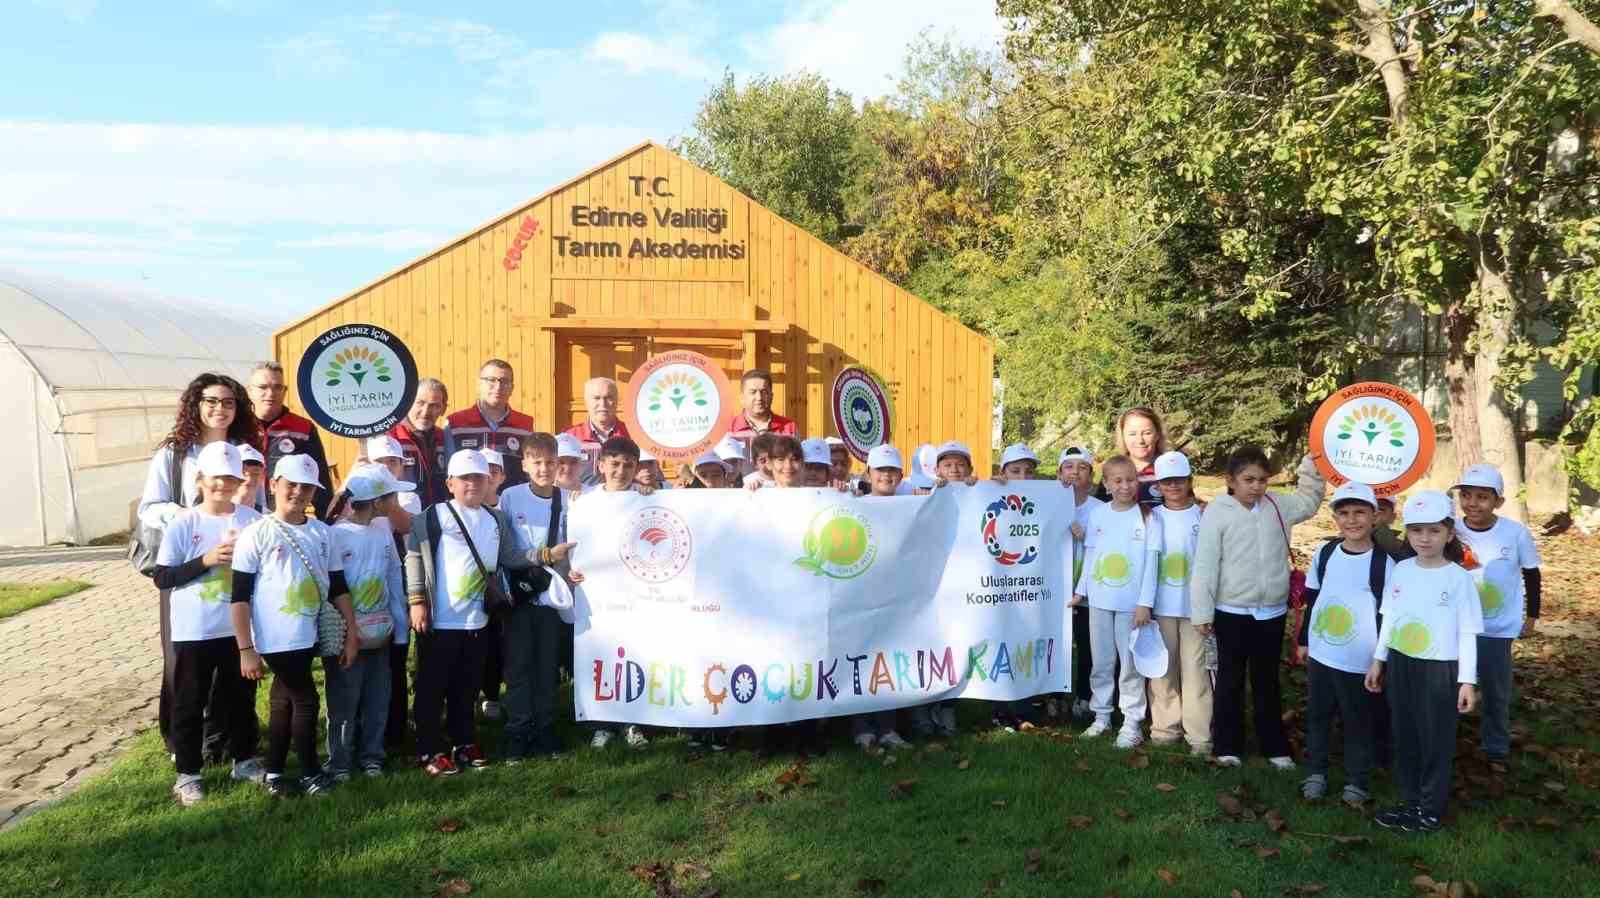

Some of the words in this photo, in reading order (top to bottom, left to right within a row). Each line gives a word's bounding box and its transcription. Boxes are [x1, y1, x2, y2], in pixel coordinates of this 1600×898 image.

[628, 176, 674, 198] T.C.
[571, 205, 647, 228] Edirne
[653, 207, 728, 233] Valiliği
[553, 235, 622, 258] Tarım
[627, 237, 745, 260] Akademisi
[320, 327, 369, 346] SAĞLIĞINIZ
[371, 329, 390, 342] İÇİN
[352, 392, 393, 402] TARIM
[1341, 385, 1393, 399] SAĞLIĞINIZ
[1394, 389, 1414, 405] İÇİN
[330, 422, 342, 432] İYİ
[344, 427, 373, 436] TARIMI
[1360, 452, 1403, 466] TARIM
[1009, 524, 1040, 537] 2025
[980, 575, 1044, 588] Uluslararası
[966, 590, 1039, 606] Kooperatifler
[593, 646, 693, 707] LİDER
[703, 657, 839, 715] ÇOCUK
[846, 646, 958, 696] TARIM
[966, 638, 1054, 683] KAMPI
